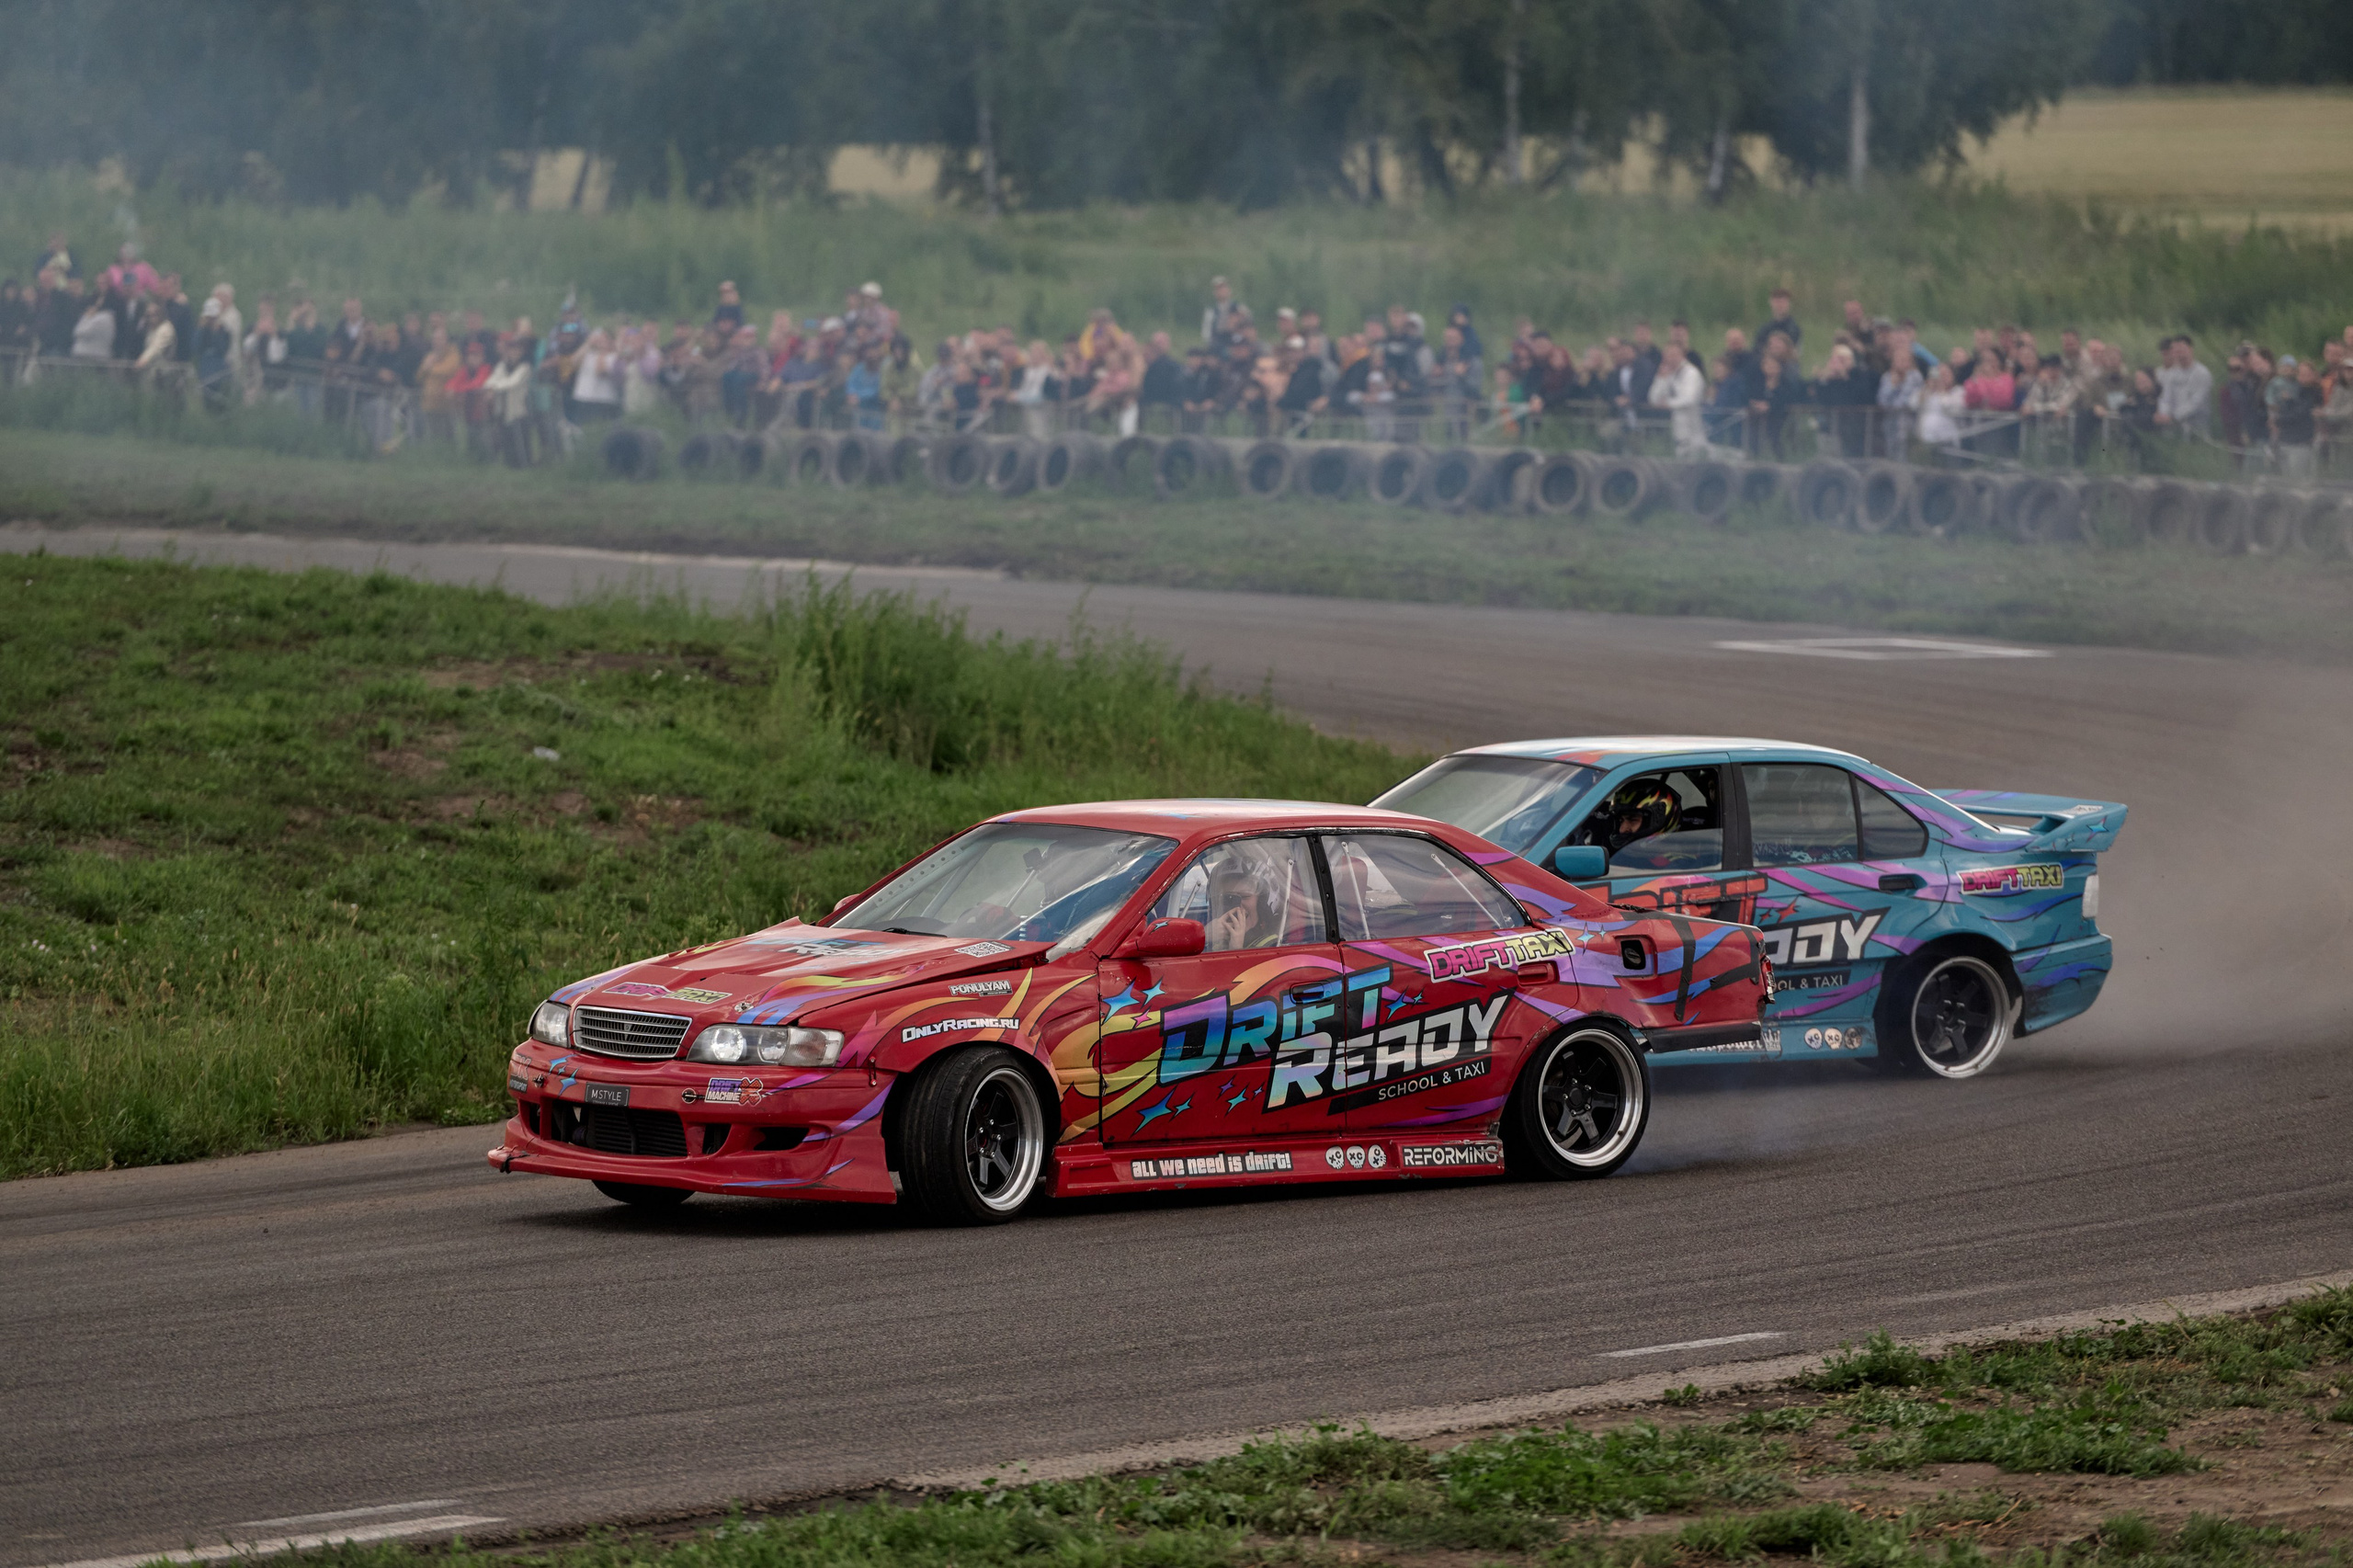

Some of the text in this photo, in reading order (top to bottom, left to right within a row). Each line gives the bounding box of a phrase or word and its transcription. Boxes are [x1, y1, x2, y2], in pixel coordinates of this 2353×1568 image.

[1763, 915, 1881, 965] ADY
[950, 980, 1011, 995] PONULYAM
[1800, 978, 1809, 989] &
[1813, 974, 1843, 987] TAXI
[1267, 994, 1509, 1109] READY
[1379, 1061, 1485, 1101] SCHOOL & TAXI
[707, 1091, 741, 1101] MACHINE
[1187, 1153, 1226, 1175] need
[1227, 1154, 1243, 1173] is
